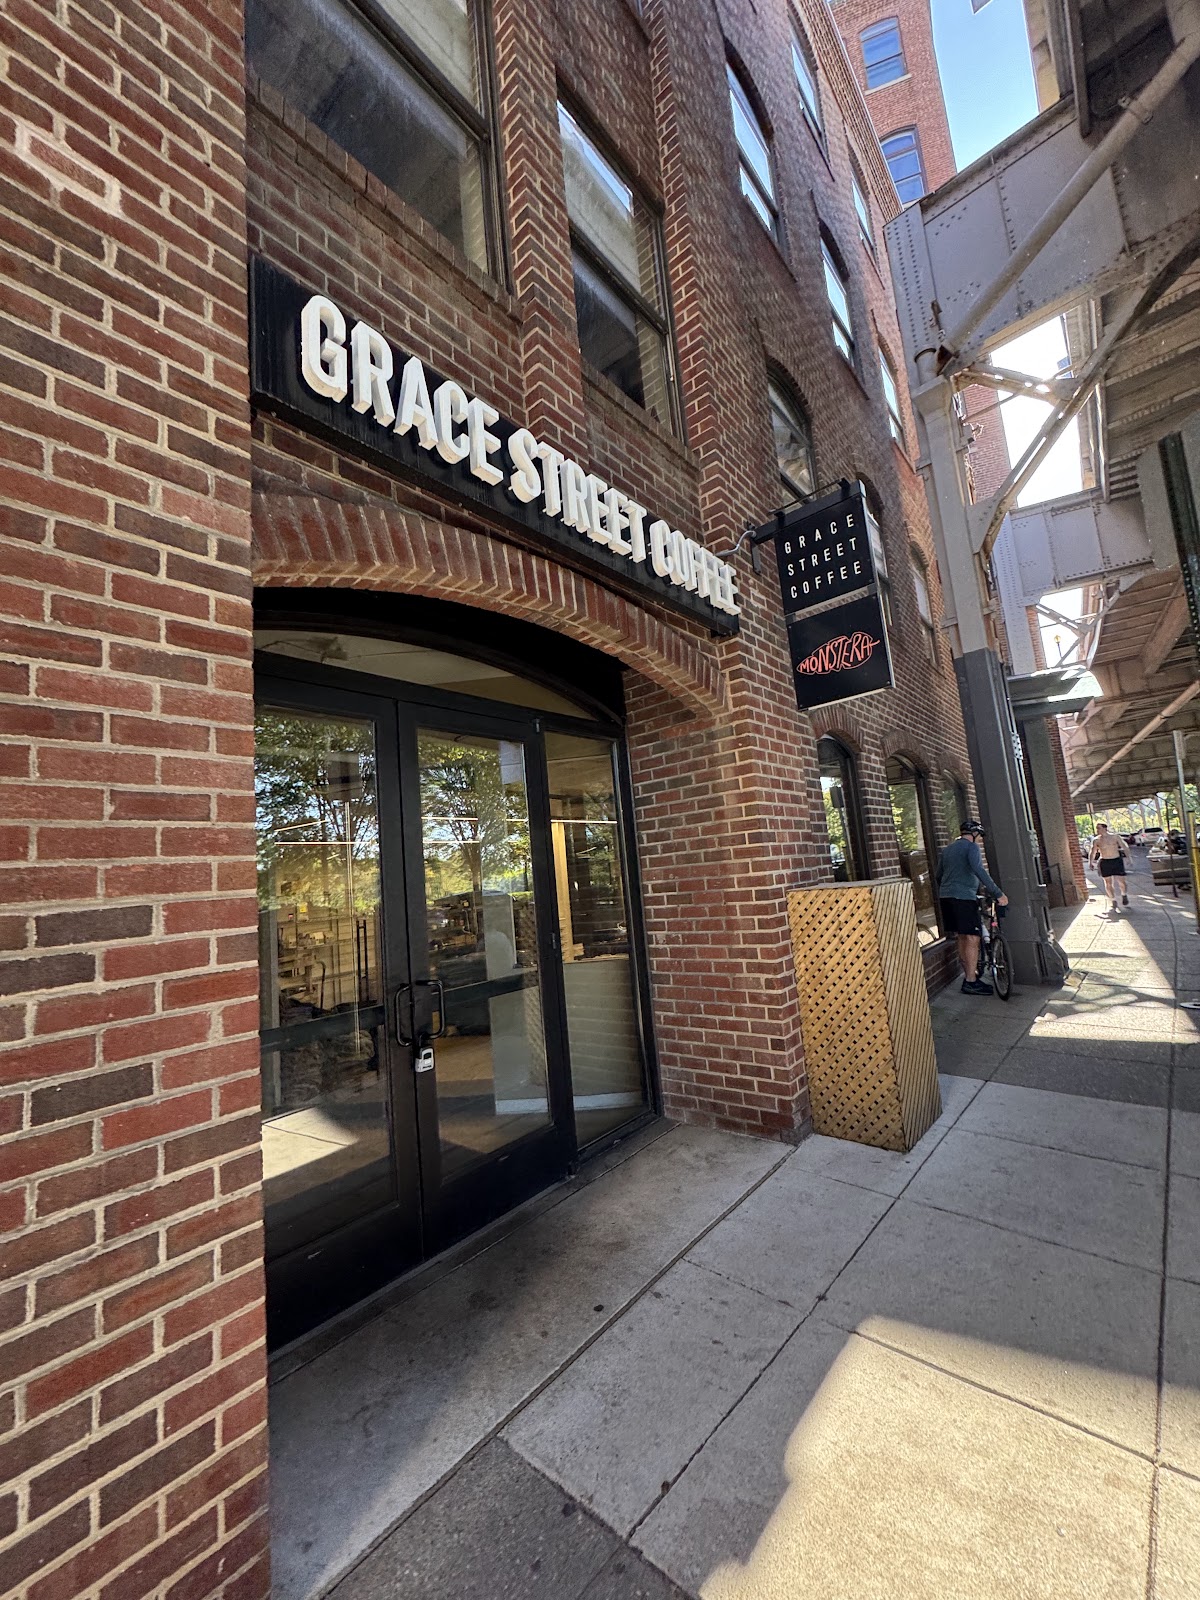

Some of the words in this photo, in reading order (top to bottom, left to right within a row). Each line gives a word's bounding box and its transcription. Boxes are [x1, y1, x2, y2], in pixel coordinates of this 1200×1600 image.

[301, 294, 504, 486] GRACE
[508, 427, 647, 563] STREET
[649, 518, 741, 615] COFFEE
[785, 514, 854, 554] GRACE
[787, 537, 857, 577] STREET
[790, 561, 862, 598] COFFEE
[800, 633, 875, 673] MONSTERA
